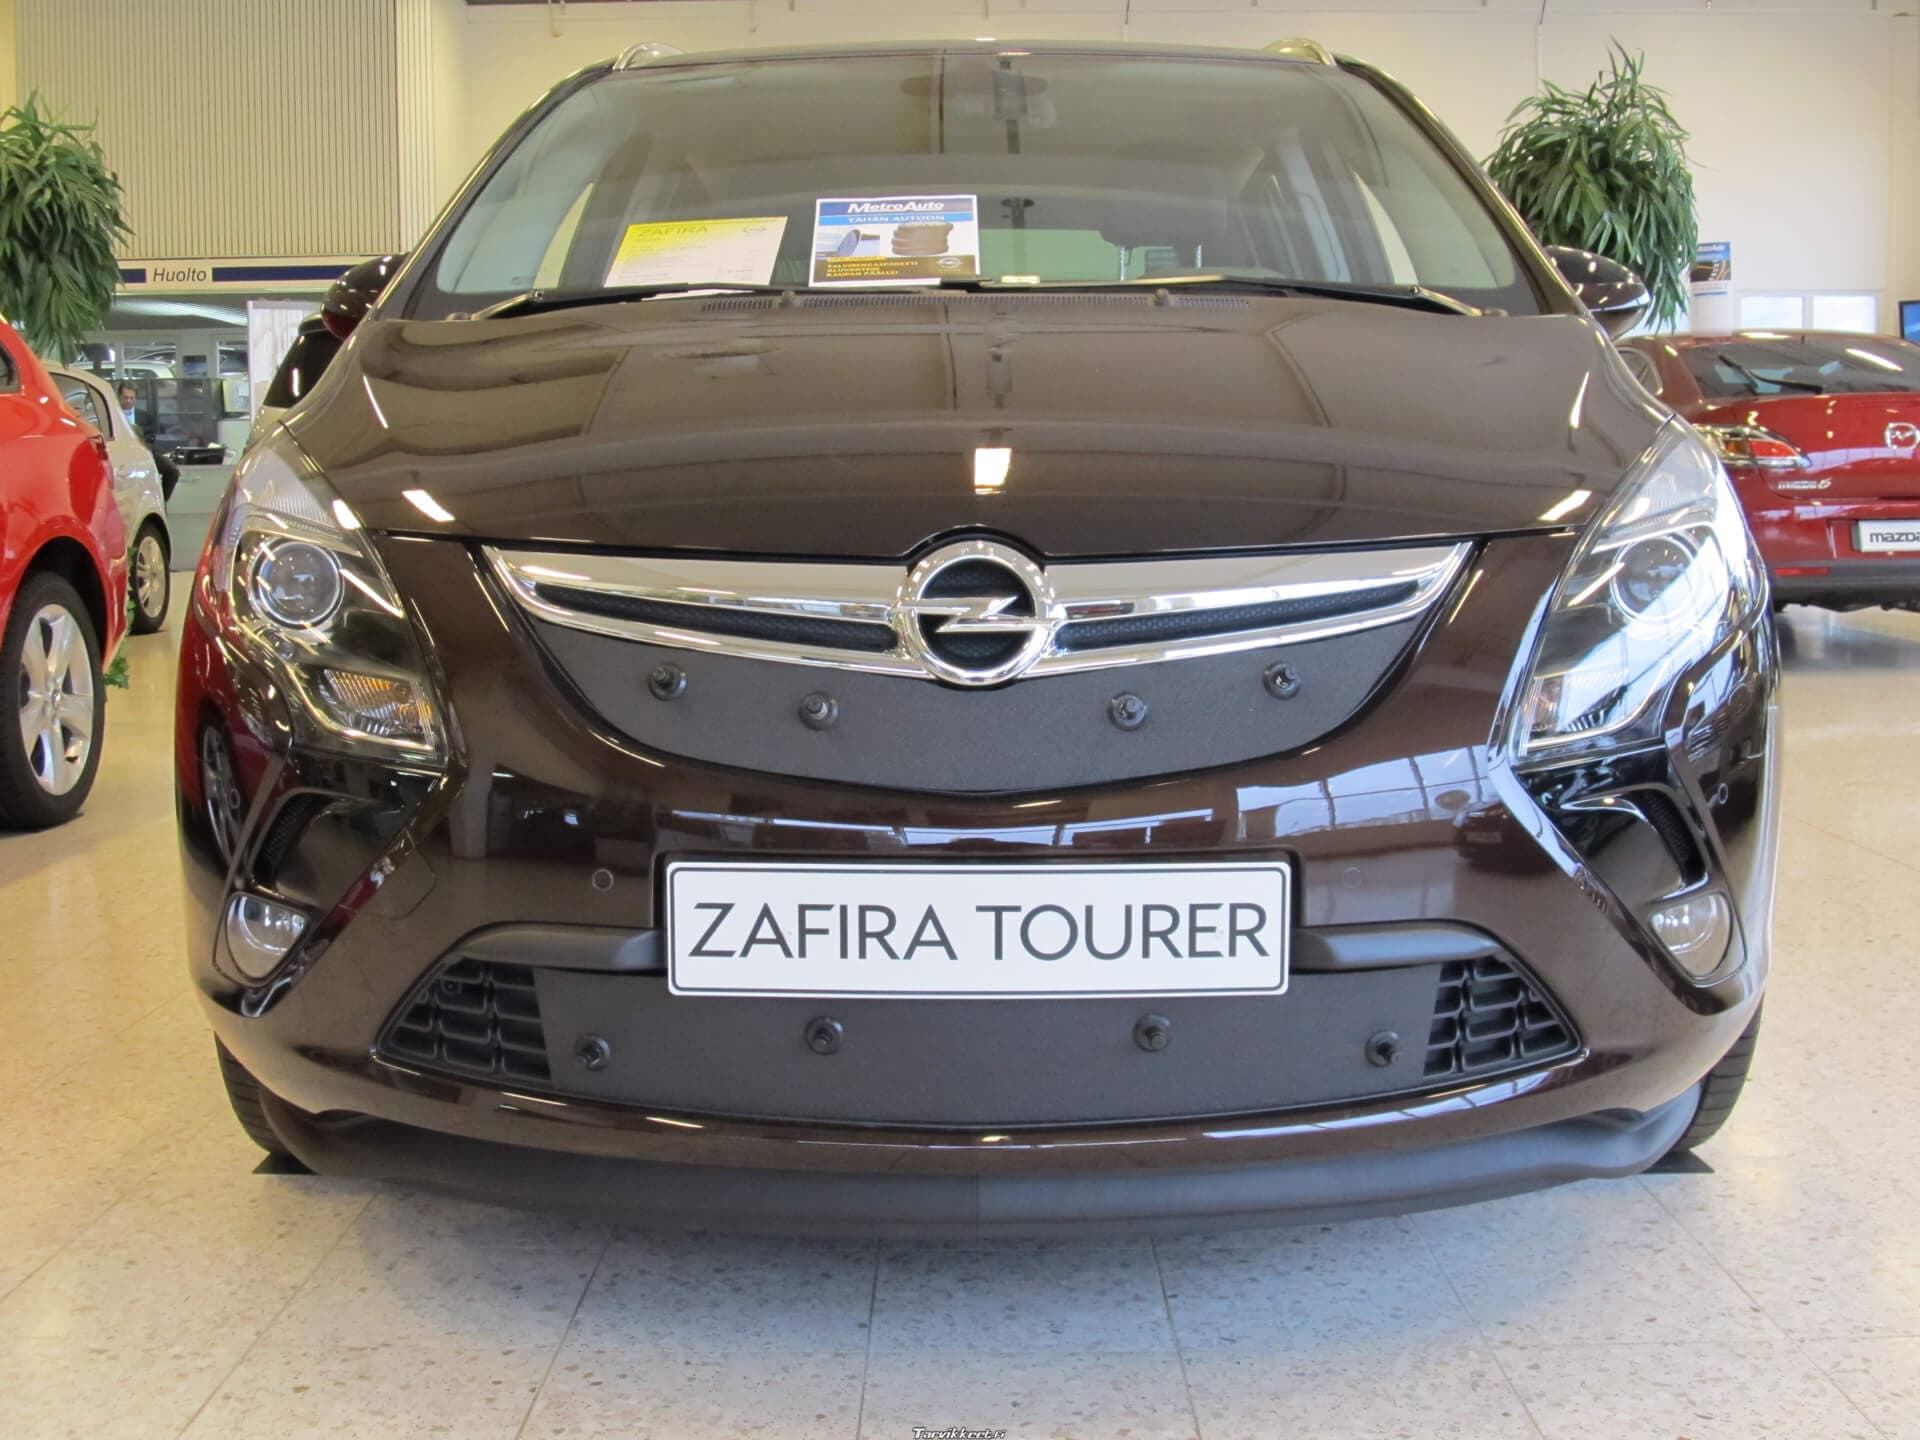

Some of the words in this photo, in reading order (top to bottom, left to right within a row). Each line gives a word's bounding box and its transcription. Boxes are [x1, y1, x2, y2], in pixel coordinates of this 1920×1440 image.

[848, 201, 945, 214] MetroAuto
[892, 214, 945, 222] AUTOON
[637, 224, 709, 237] ZAFIRA
[153, 268, 207, 282] Huolto
[687, 902, 958, 960] ZAFIRA
[976, 902, 1271, 960] TOURER
